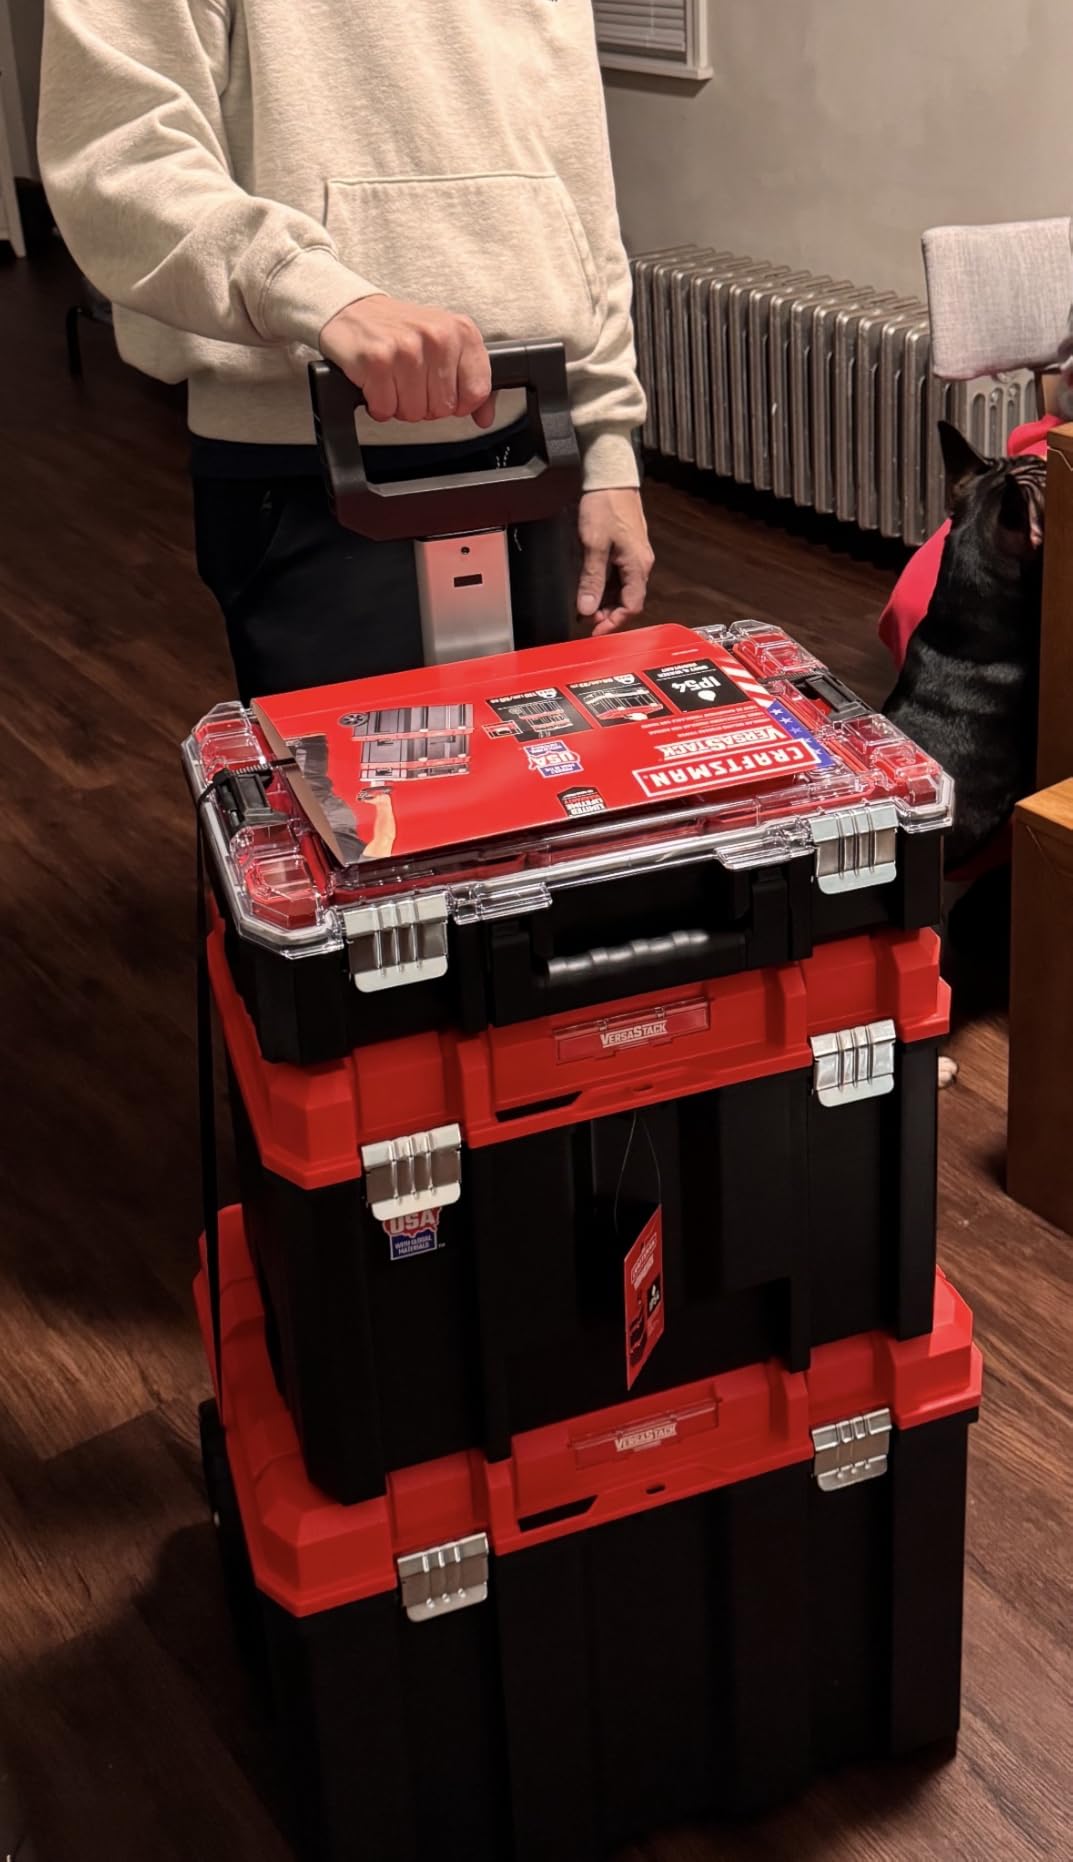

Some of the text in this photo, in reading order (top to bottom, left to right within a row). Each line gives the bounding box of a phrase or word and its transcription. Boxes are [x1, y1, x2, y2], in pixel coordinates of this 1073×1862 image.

[671, 676, 721, 693] IP54
[531, 751, 575, 767] USA
[650, 746, 804, 787] CRAFTSMAN
[600, 1021, 667, 1047] VERSASTACK
[390, 1210, 436, 1234] USA
